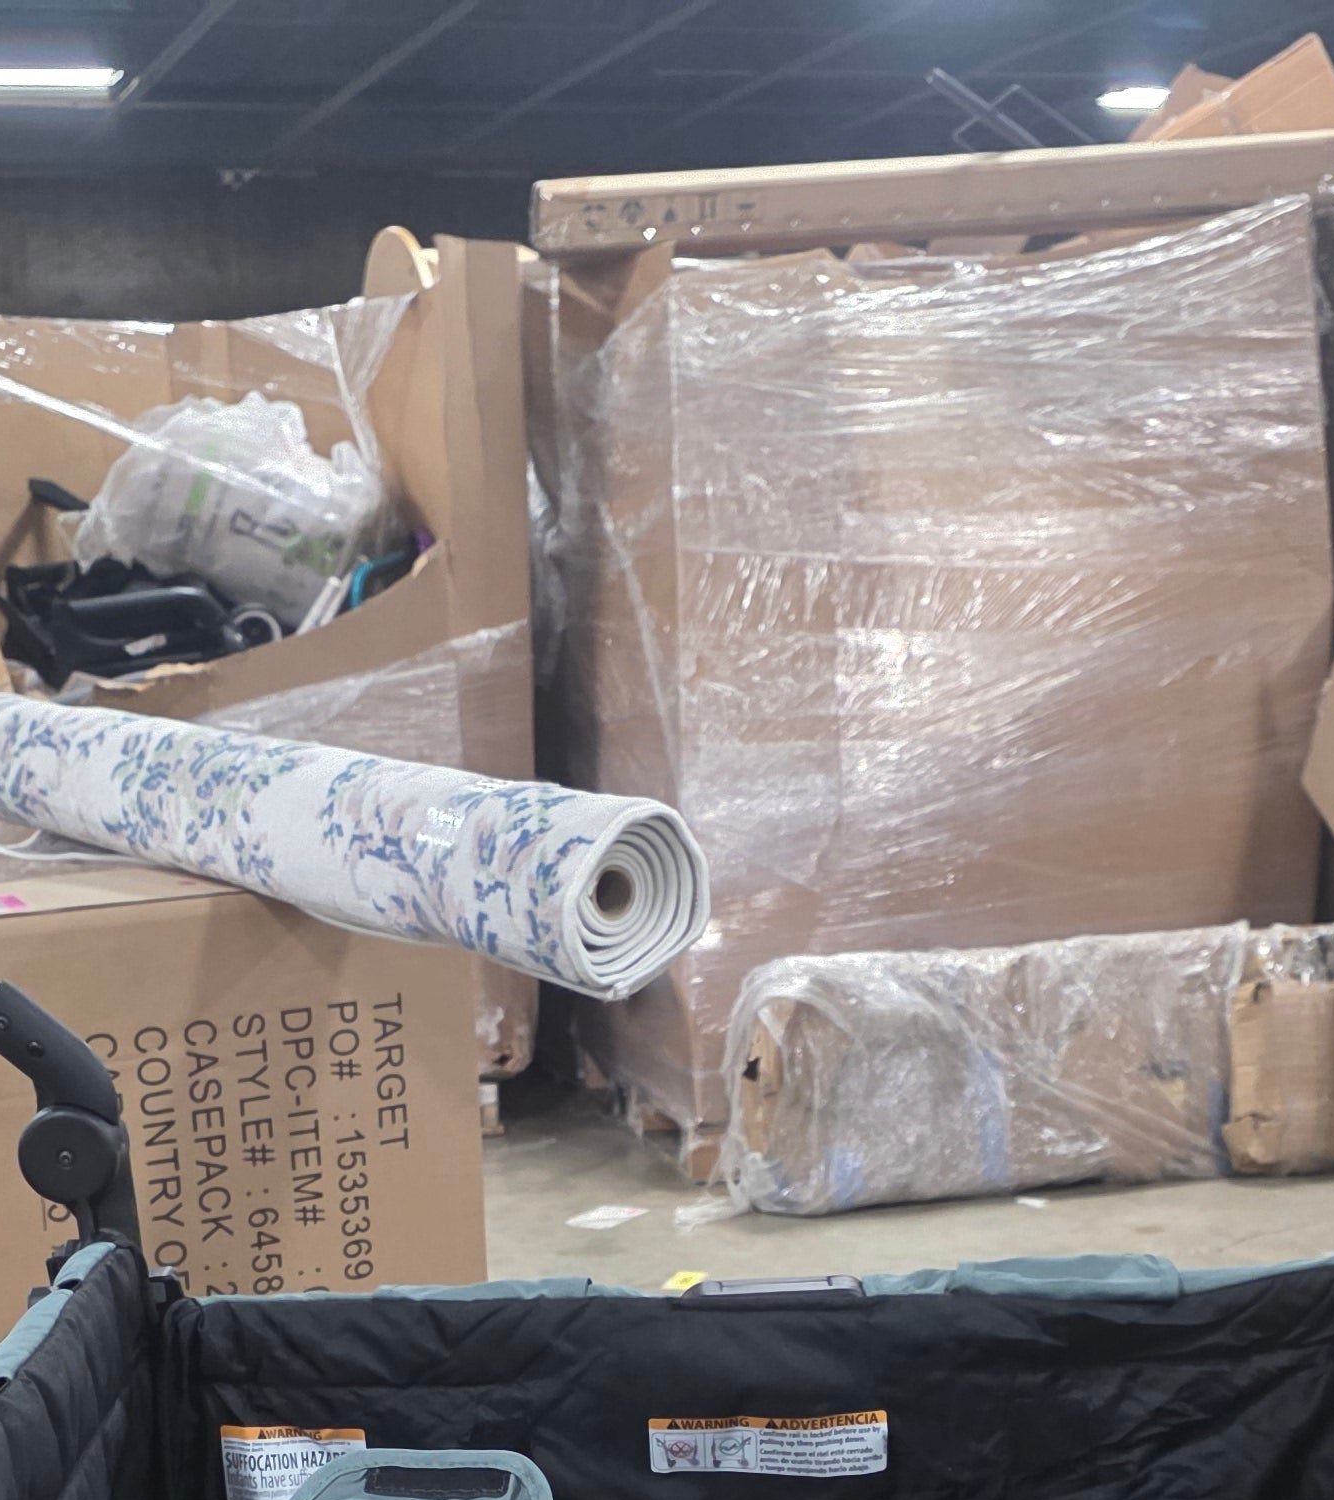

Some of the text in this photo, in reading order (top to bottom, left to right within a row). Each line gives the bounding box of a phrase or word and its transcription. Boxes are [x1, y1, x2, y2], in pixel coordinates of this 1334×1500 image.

[134, 1026, 185, 1228] COUNTRY
[183, 1020, 234, 1242] CASEPACK
[232, 1014, 276, 1166] STYLE#
[280, 1008, 326, 1227] DPC-ITEM#
[328, 1001, 374, 1281] PO# :1535369
[373, 992, 409, 1149] TARGET
[225, 1451, 298, 1472] SUFFOCATION
[261, 1471, 285, 1488] have
[266, 1428, 322, 1441] WARNING
[680, 1413, 879, 1430] WARNING ADVERTENCIA
